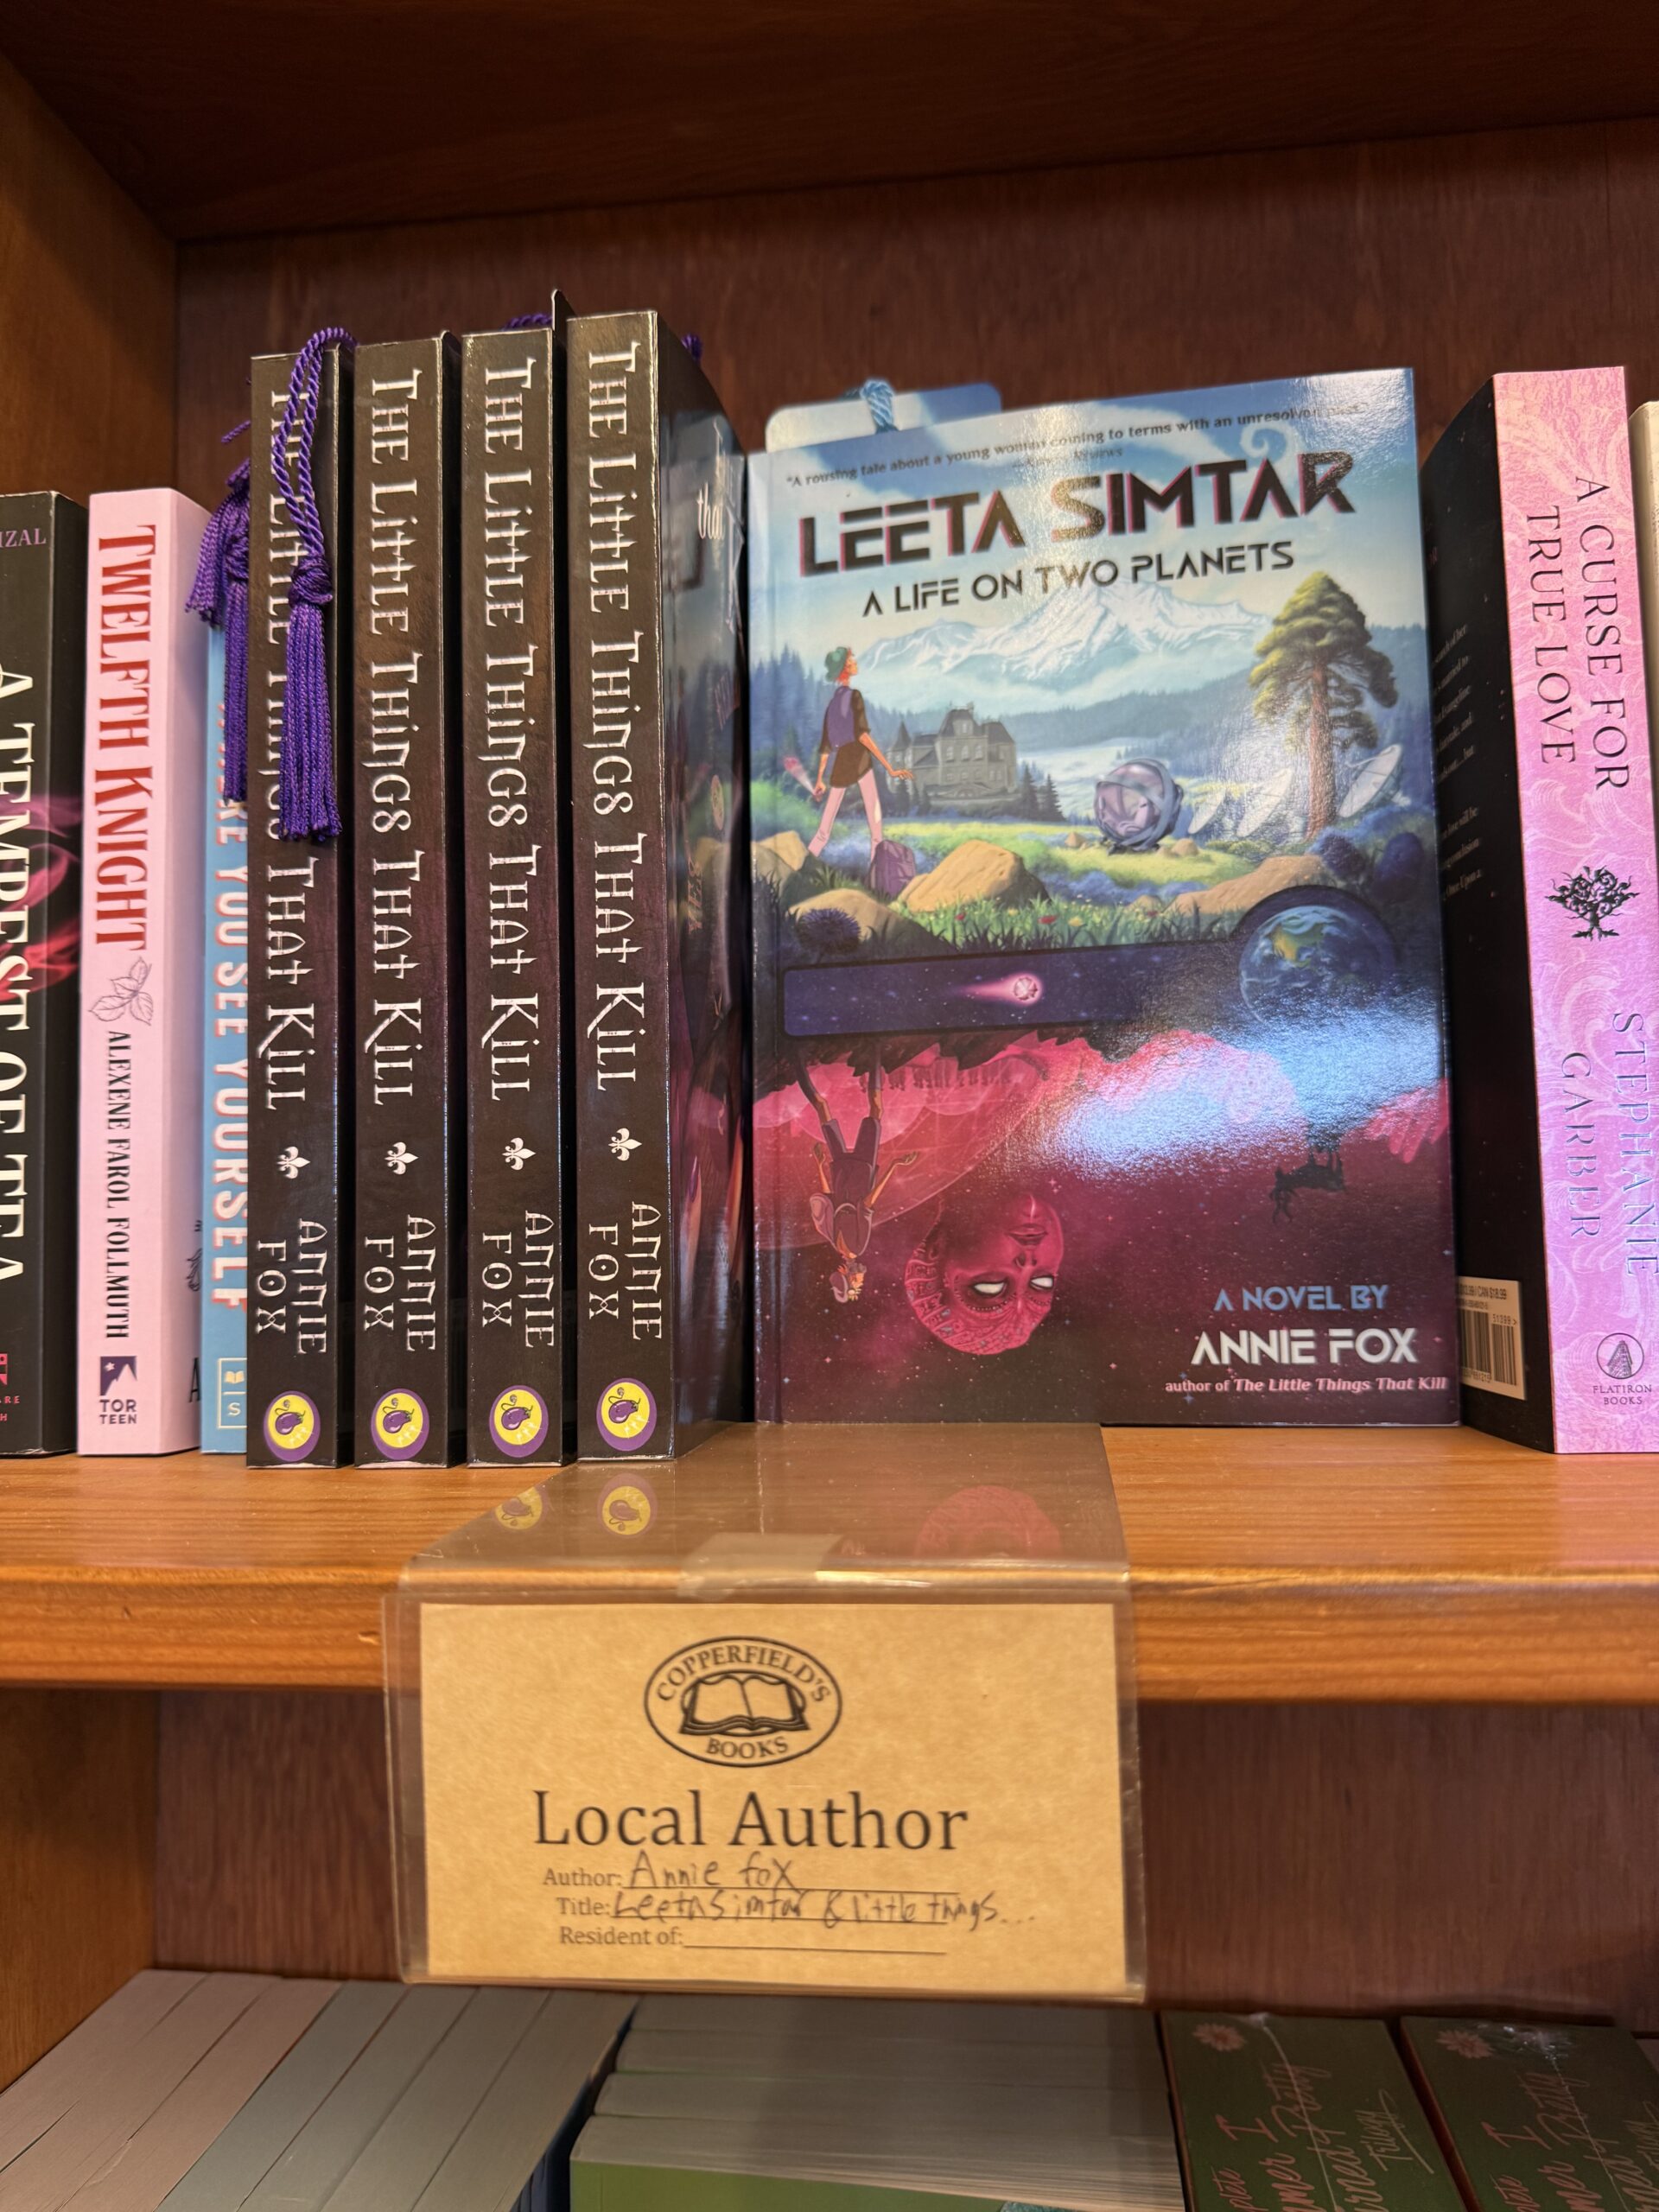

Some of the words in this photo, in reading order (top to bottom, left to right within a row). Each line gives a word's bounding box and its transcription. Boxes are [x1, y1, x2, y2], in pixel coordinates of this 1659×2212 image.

[890, 456, 931, 472] about
[934, 455, 943, 465] a
[946, 447, 990, 465] young
[1109, 429, 1124, 440] to
[1128, 422, 1173, 438] terms
[1176, 417, 1210, 431] with
[1214, 416, 1233, 428] an
[799, 489, 1027, 577] LEETA
[1051, 449, 1357, 543] SIMTAR
[1575, 476, 1610, 503] A
[861, 591, 884, 617] A
[894, 578, 960, 614] LIFE
[971, 567, 1023, 601] ON
[1034, 557, 1120, 594] TWO
[1131, 540, 1294, 583] PLANETS
[1527, 505, 1568, 622] TRUE
[1579, 524, 1624, 677] CURSE
[99, 524, 156, 749] TWELFTH
[1535, 645, 1577, 765] LOVE
[1590, 697, 1630, 791] FOR
[94, 767, 154, 950] KNIGHT
[106, 1031, 132, 1130] ALEXENE
[105, 1139, 131, 1209] FAROL
[1560, 1052, 1602, 1238] GARBER
[1612, 1013, 1659, 1277] STEPHANIE
[105, 1218, 131, 1340] FOLLMUTH
[256, 1240, 287, 1337] FOX
[363, 1236, 395, 1332] FOX
[481, 1232, 513, 1328] FOX
[588, 1223, 620, 1319] FOX
[1214, 1289, 1234, 1312] A
[1243, 1285, 1341, 1312] NOVEL
[1351, 1284, 1389, 1310] BY
[1191, 1328, 1316, 1365] ANNIE
[1329, 1327, 1419, 1364] FOX
[99, 1399, 137, 1412] TOR
[99, 1413, 137, 1424] TEEN
[1165, 1380, 1211, 1394] author
[1215, 1379, 1230, 1393] of
[1233, 1378, 1264, 1392] The
[1268, 1377, 1311, 1392] Little
[1316, 1376, 1370, 1395] Things
[1376, 1376, 1413, 1390] That
[1418, 1376, 1449, 1390] Kill
[1592, 1384, 1654, 1395] FLATIRON
[1603, 1395, 1644, 1406] BOOKS
[656, 1643, 832, 1704] COPPERFIELD'S
[706, 1735, 790, 1760] BOOKS
[532, 1789, 704, 1847] Local
[728, 1790, 969, 1851] Author
[543, 1866, 623, 1886] Author:
[629, 1849, 721, 1890] Annie
[556, 1897, 612, 1916] Title:
[560, 1926, 651, 1946] Resident
[657, 1926, 683, 1946] of:
